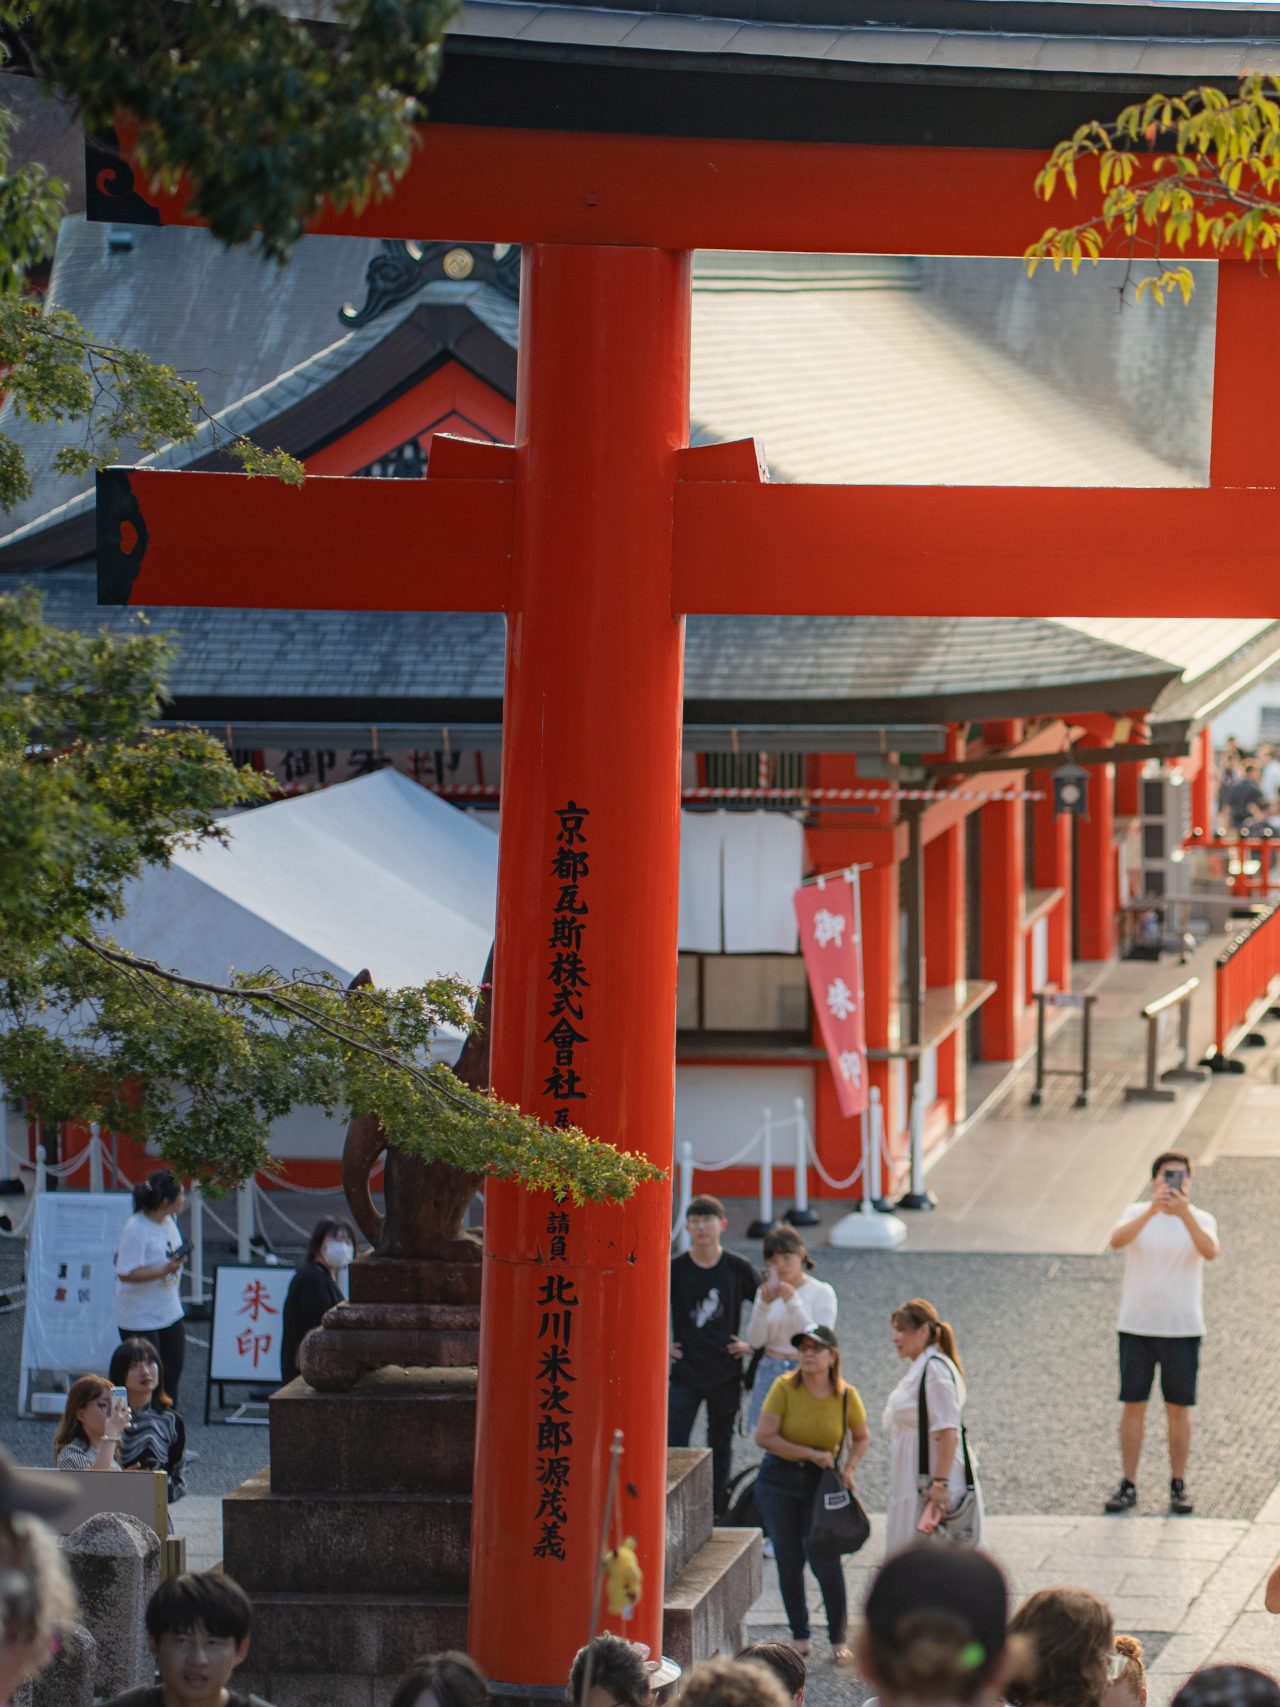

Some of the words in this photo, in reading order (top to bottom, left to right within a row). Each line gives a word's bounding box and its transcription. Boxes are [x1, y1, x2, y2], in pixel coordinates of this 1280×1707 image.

[814, 908, 862, 1089] 御朱印
[235, 1278, 280, 1369] 朱印
